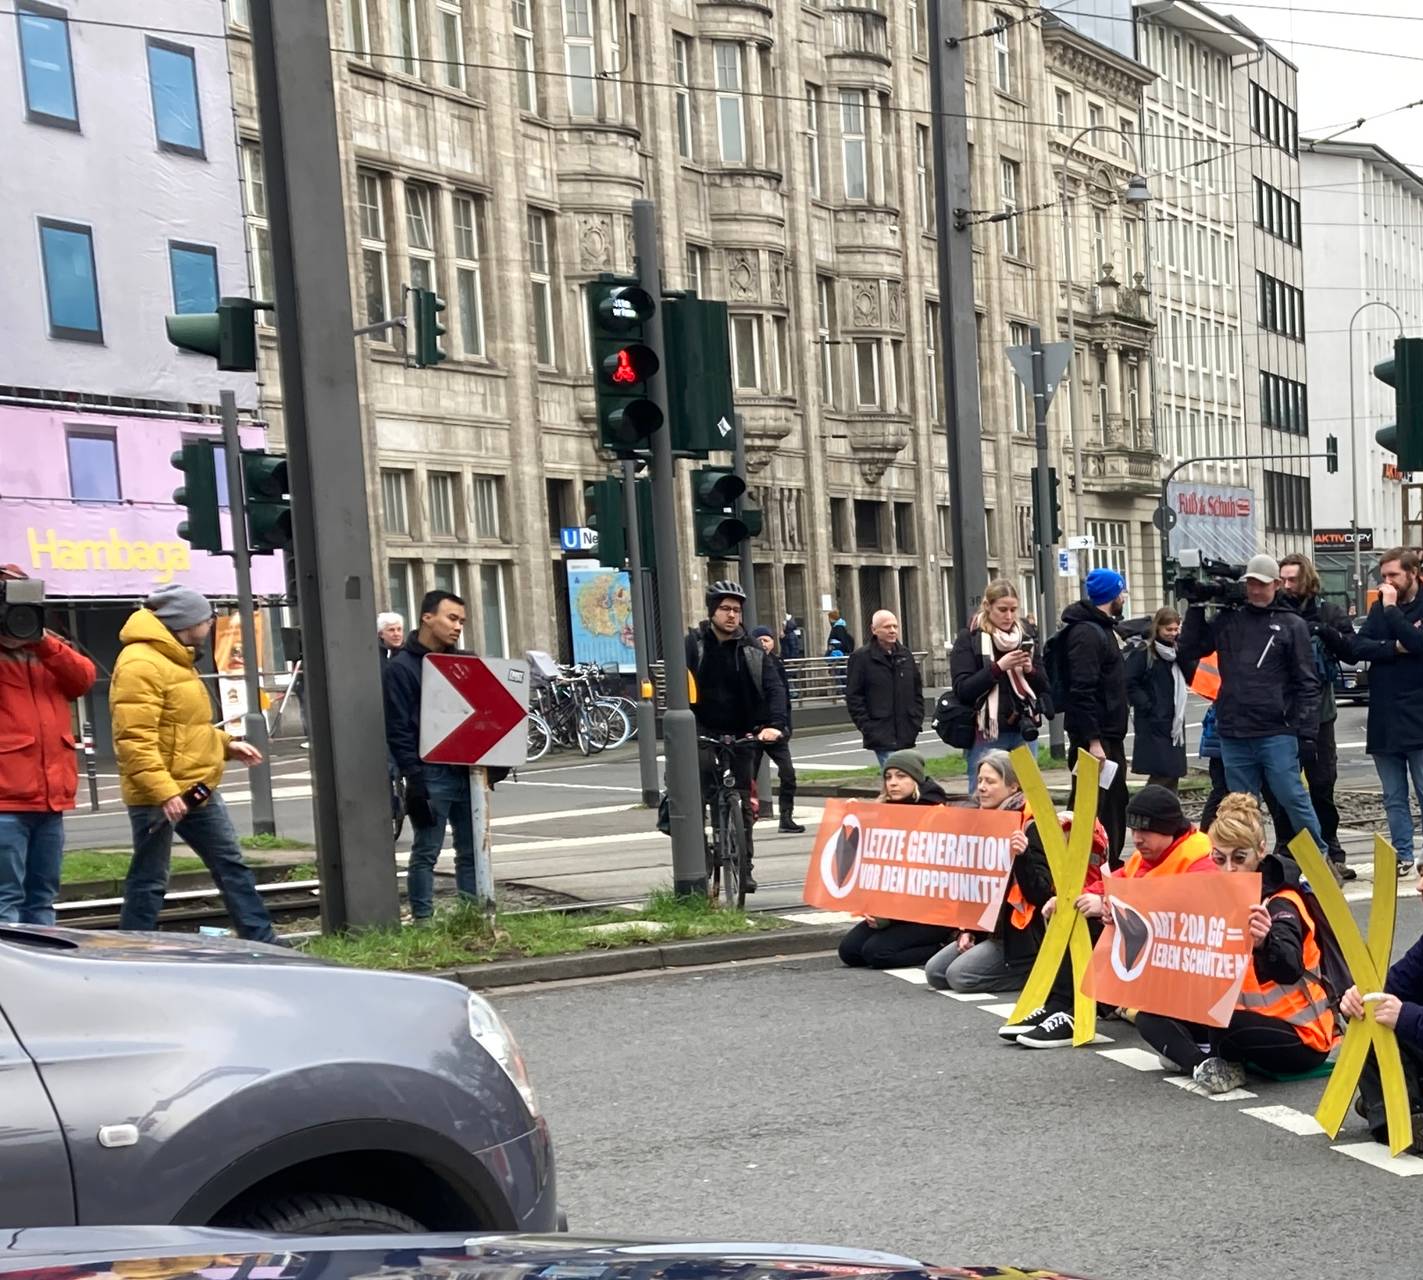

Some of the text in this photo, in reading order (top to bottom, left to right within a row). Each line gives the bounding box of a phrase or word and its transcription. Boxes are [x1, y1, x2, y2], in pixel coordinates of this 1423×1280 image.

[1207, 495, 1236, 518] Schuh
[563, 530, 599, 548] U Ne
[1312, 533, 1371, 543] AKTIVCOPY
[26, 527, 191, 584] Hambaga
[862, 827, 1011, 872] LETZTE GENERATION
[859, 863, 882, 890] VOR
[882, 865, 904, 894] DEN
[1148, 911, 1244, 947] ART. 20A GG =
[1151, 943, 1181, 970] LEBEN
